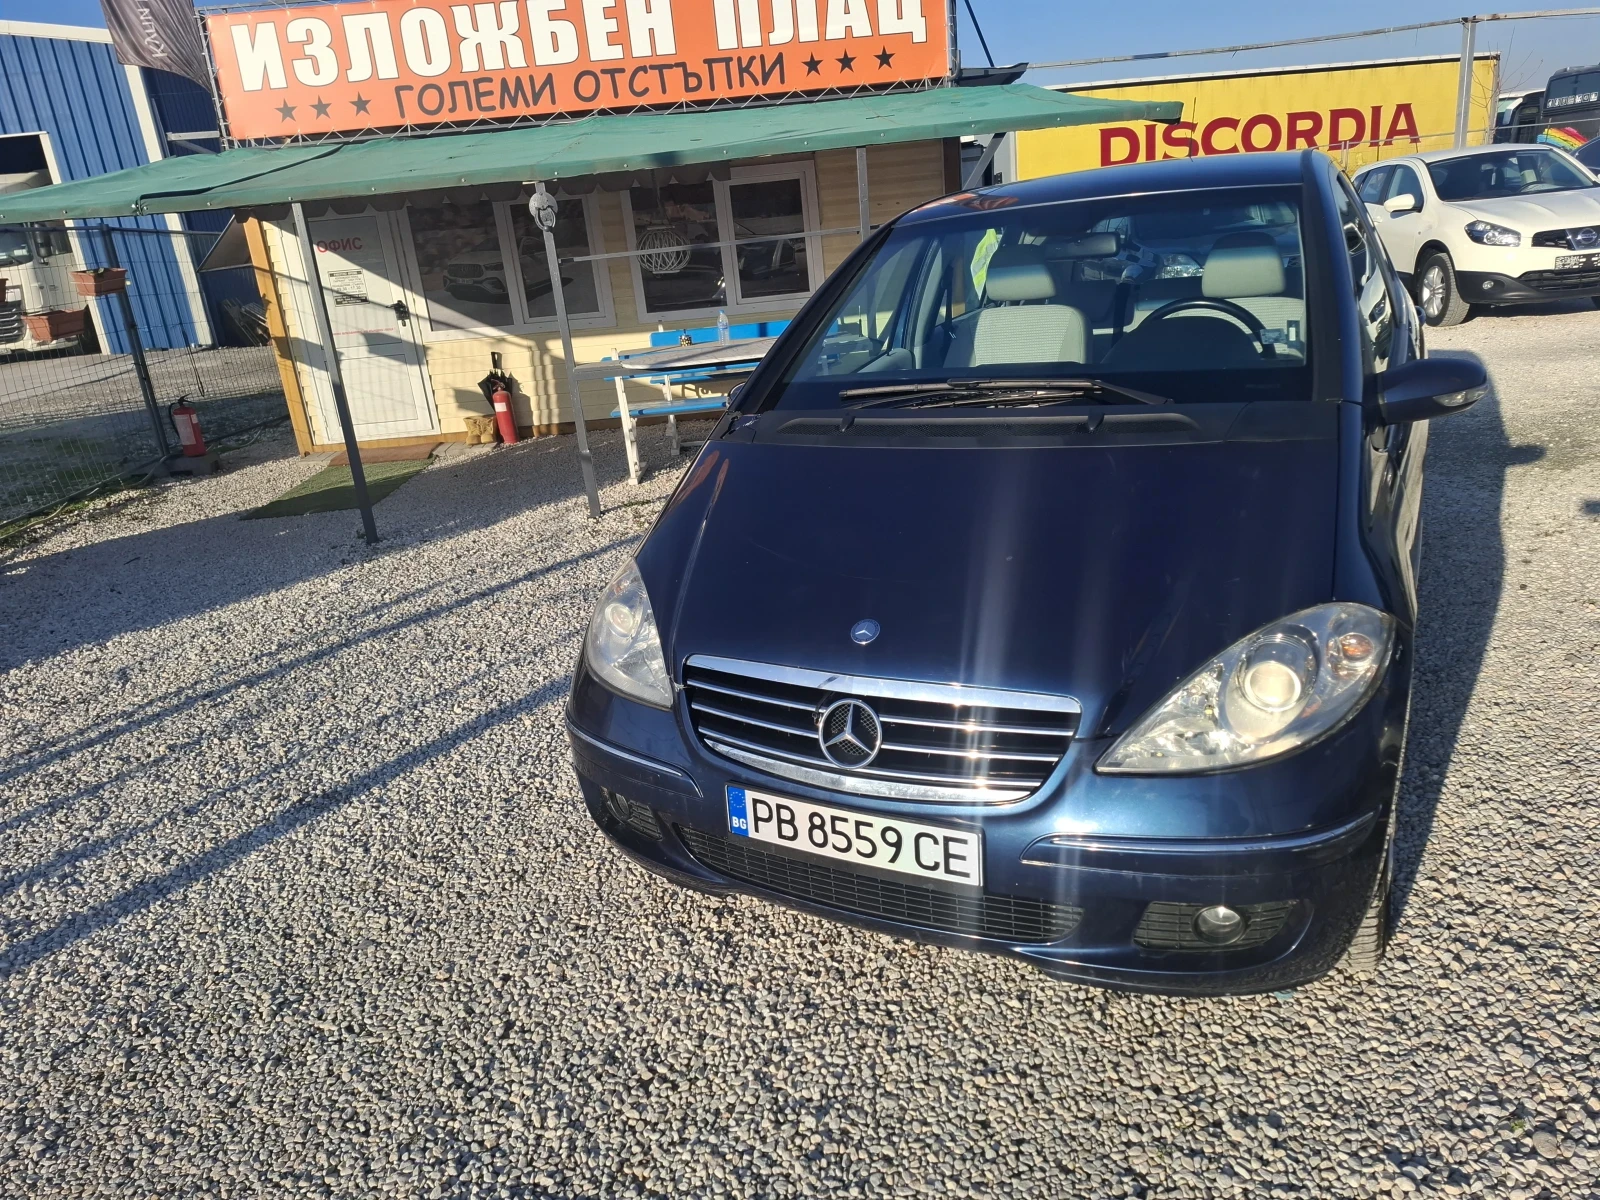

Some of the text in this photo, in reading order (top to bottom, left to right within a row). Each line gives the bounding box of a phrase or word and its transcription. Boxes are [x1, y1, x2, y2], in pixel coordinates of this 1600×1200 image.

[229, 0, 928, 92] ИЗЛОЖБЕН ПЛАЦ
[394, 52, 786, 119] ГОЛЕМИ ОТСТЪПКИ
[1098, 102, 1422, 168] DISCORDIA
[316, 237, 363, 253] ОФИС
[732, 816, 747, 830] BG
[751, 797, 971, 879] PB 8559 CE
